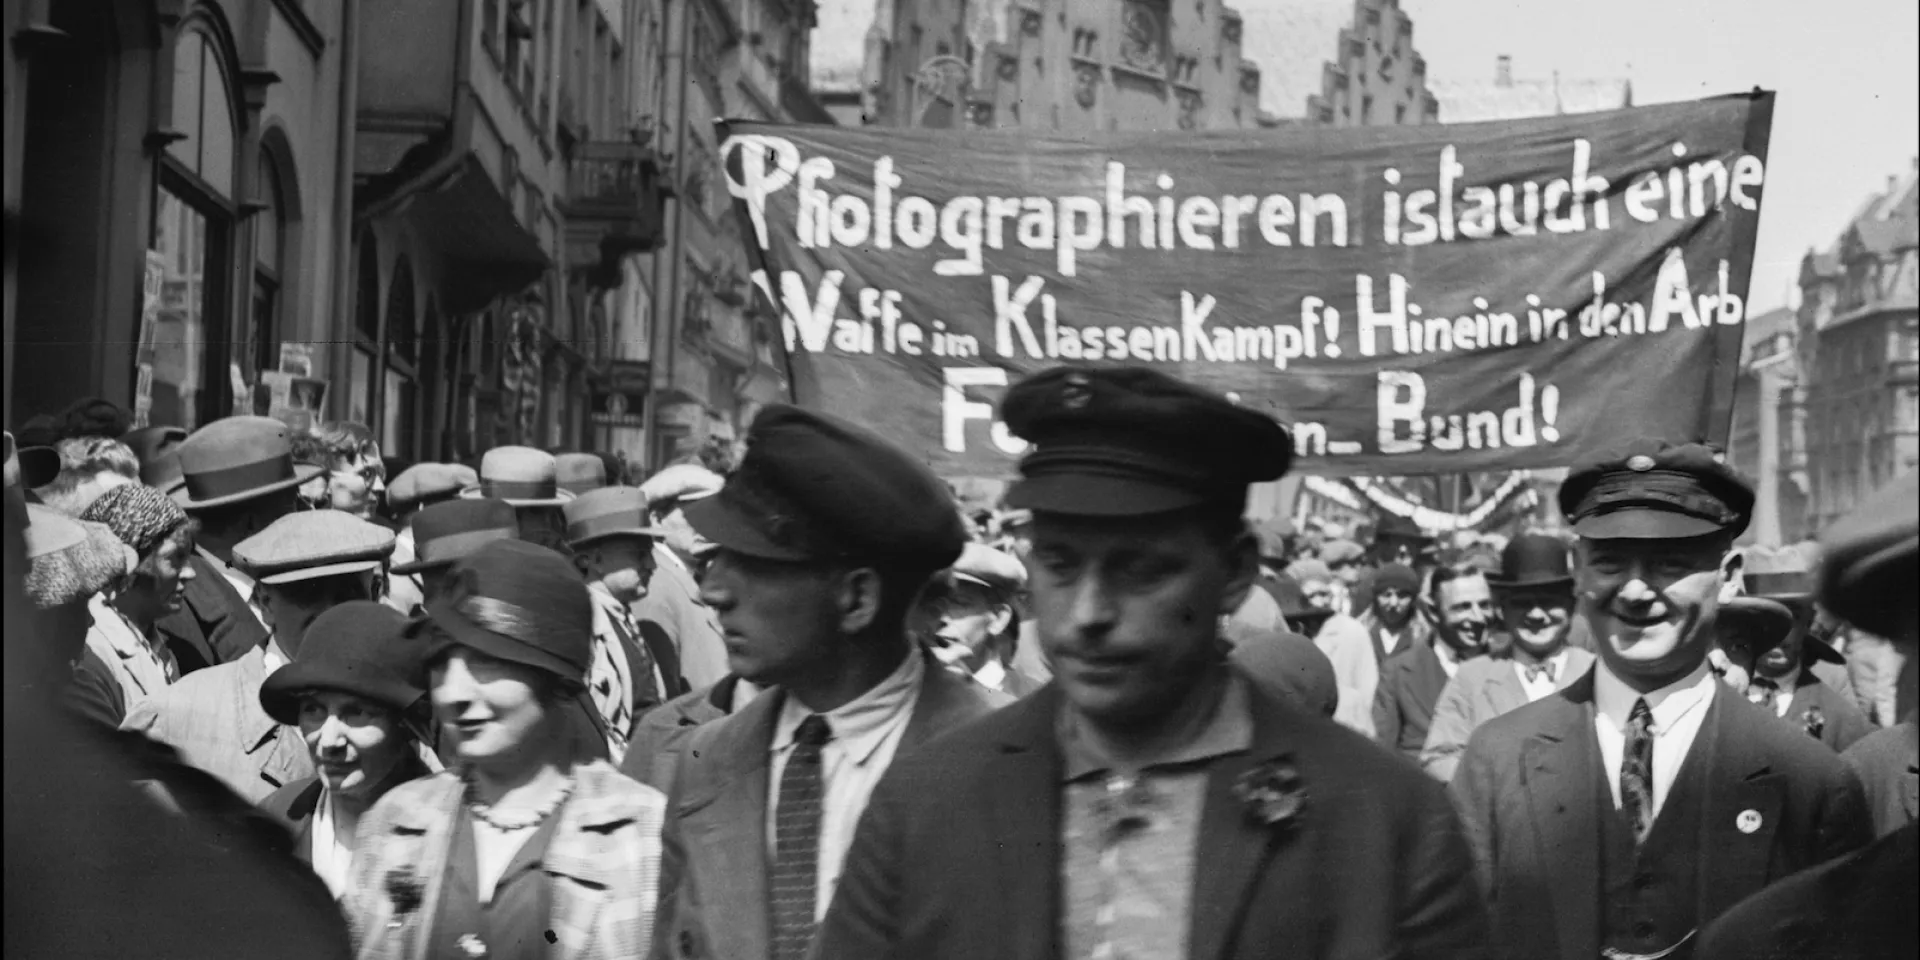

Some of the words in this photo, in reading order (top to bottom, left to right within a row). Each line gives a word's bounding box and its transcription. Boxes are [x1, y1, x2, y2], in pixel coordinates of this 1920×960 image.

[719, 134, 1348, 276] Photographieren
[1624, 141, 1764, 224] eine
[751, 268, 923, 355] Waffe
[931, 319, 979, 358] im
[1356, 272, 1518, 356] Hinein
[1526, 293, 1569, 344] in
[1578, 270, 1646, 338] den
[1648, 246, 1744, 334] Arb
[1377, 368, 1560, 454] Bund!
